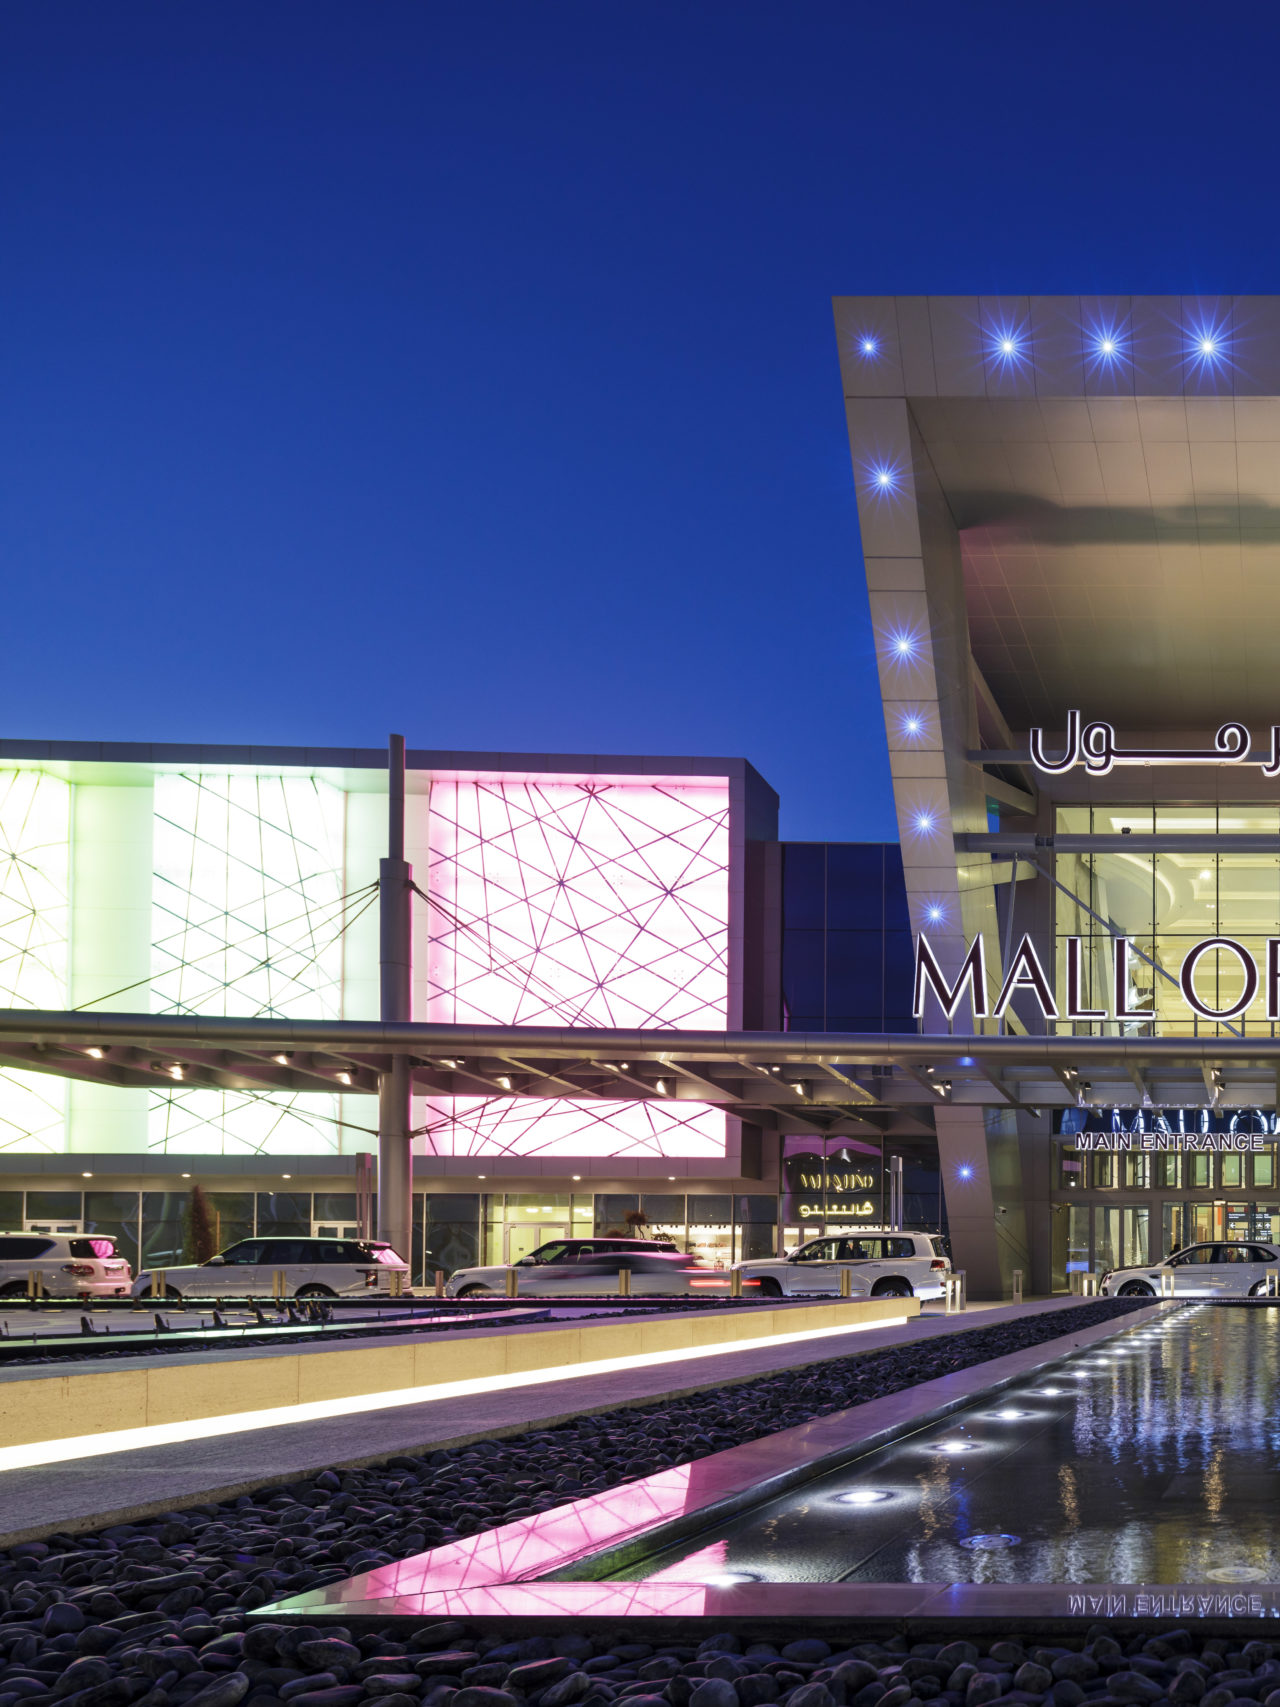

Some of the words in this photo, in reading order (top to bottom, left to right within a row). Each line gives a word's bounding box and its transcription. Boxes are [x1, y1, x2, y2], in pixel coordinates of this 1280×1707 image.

[1029, 709, 1250, 776] مول
[912, 931, 1156, 1021] MALL
[1075, 1132, 1131, 1150] MAIN
[1139, 1132, 1264, 1151] ENTRANCE
